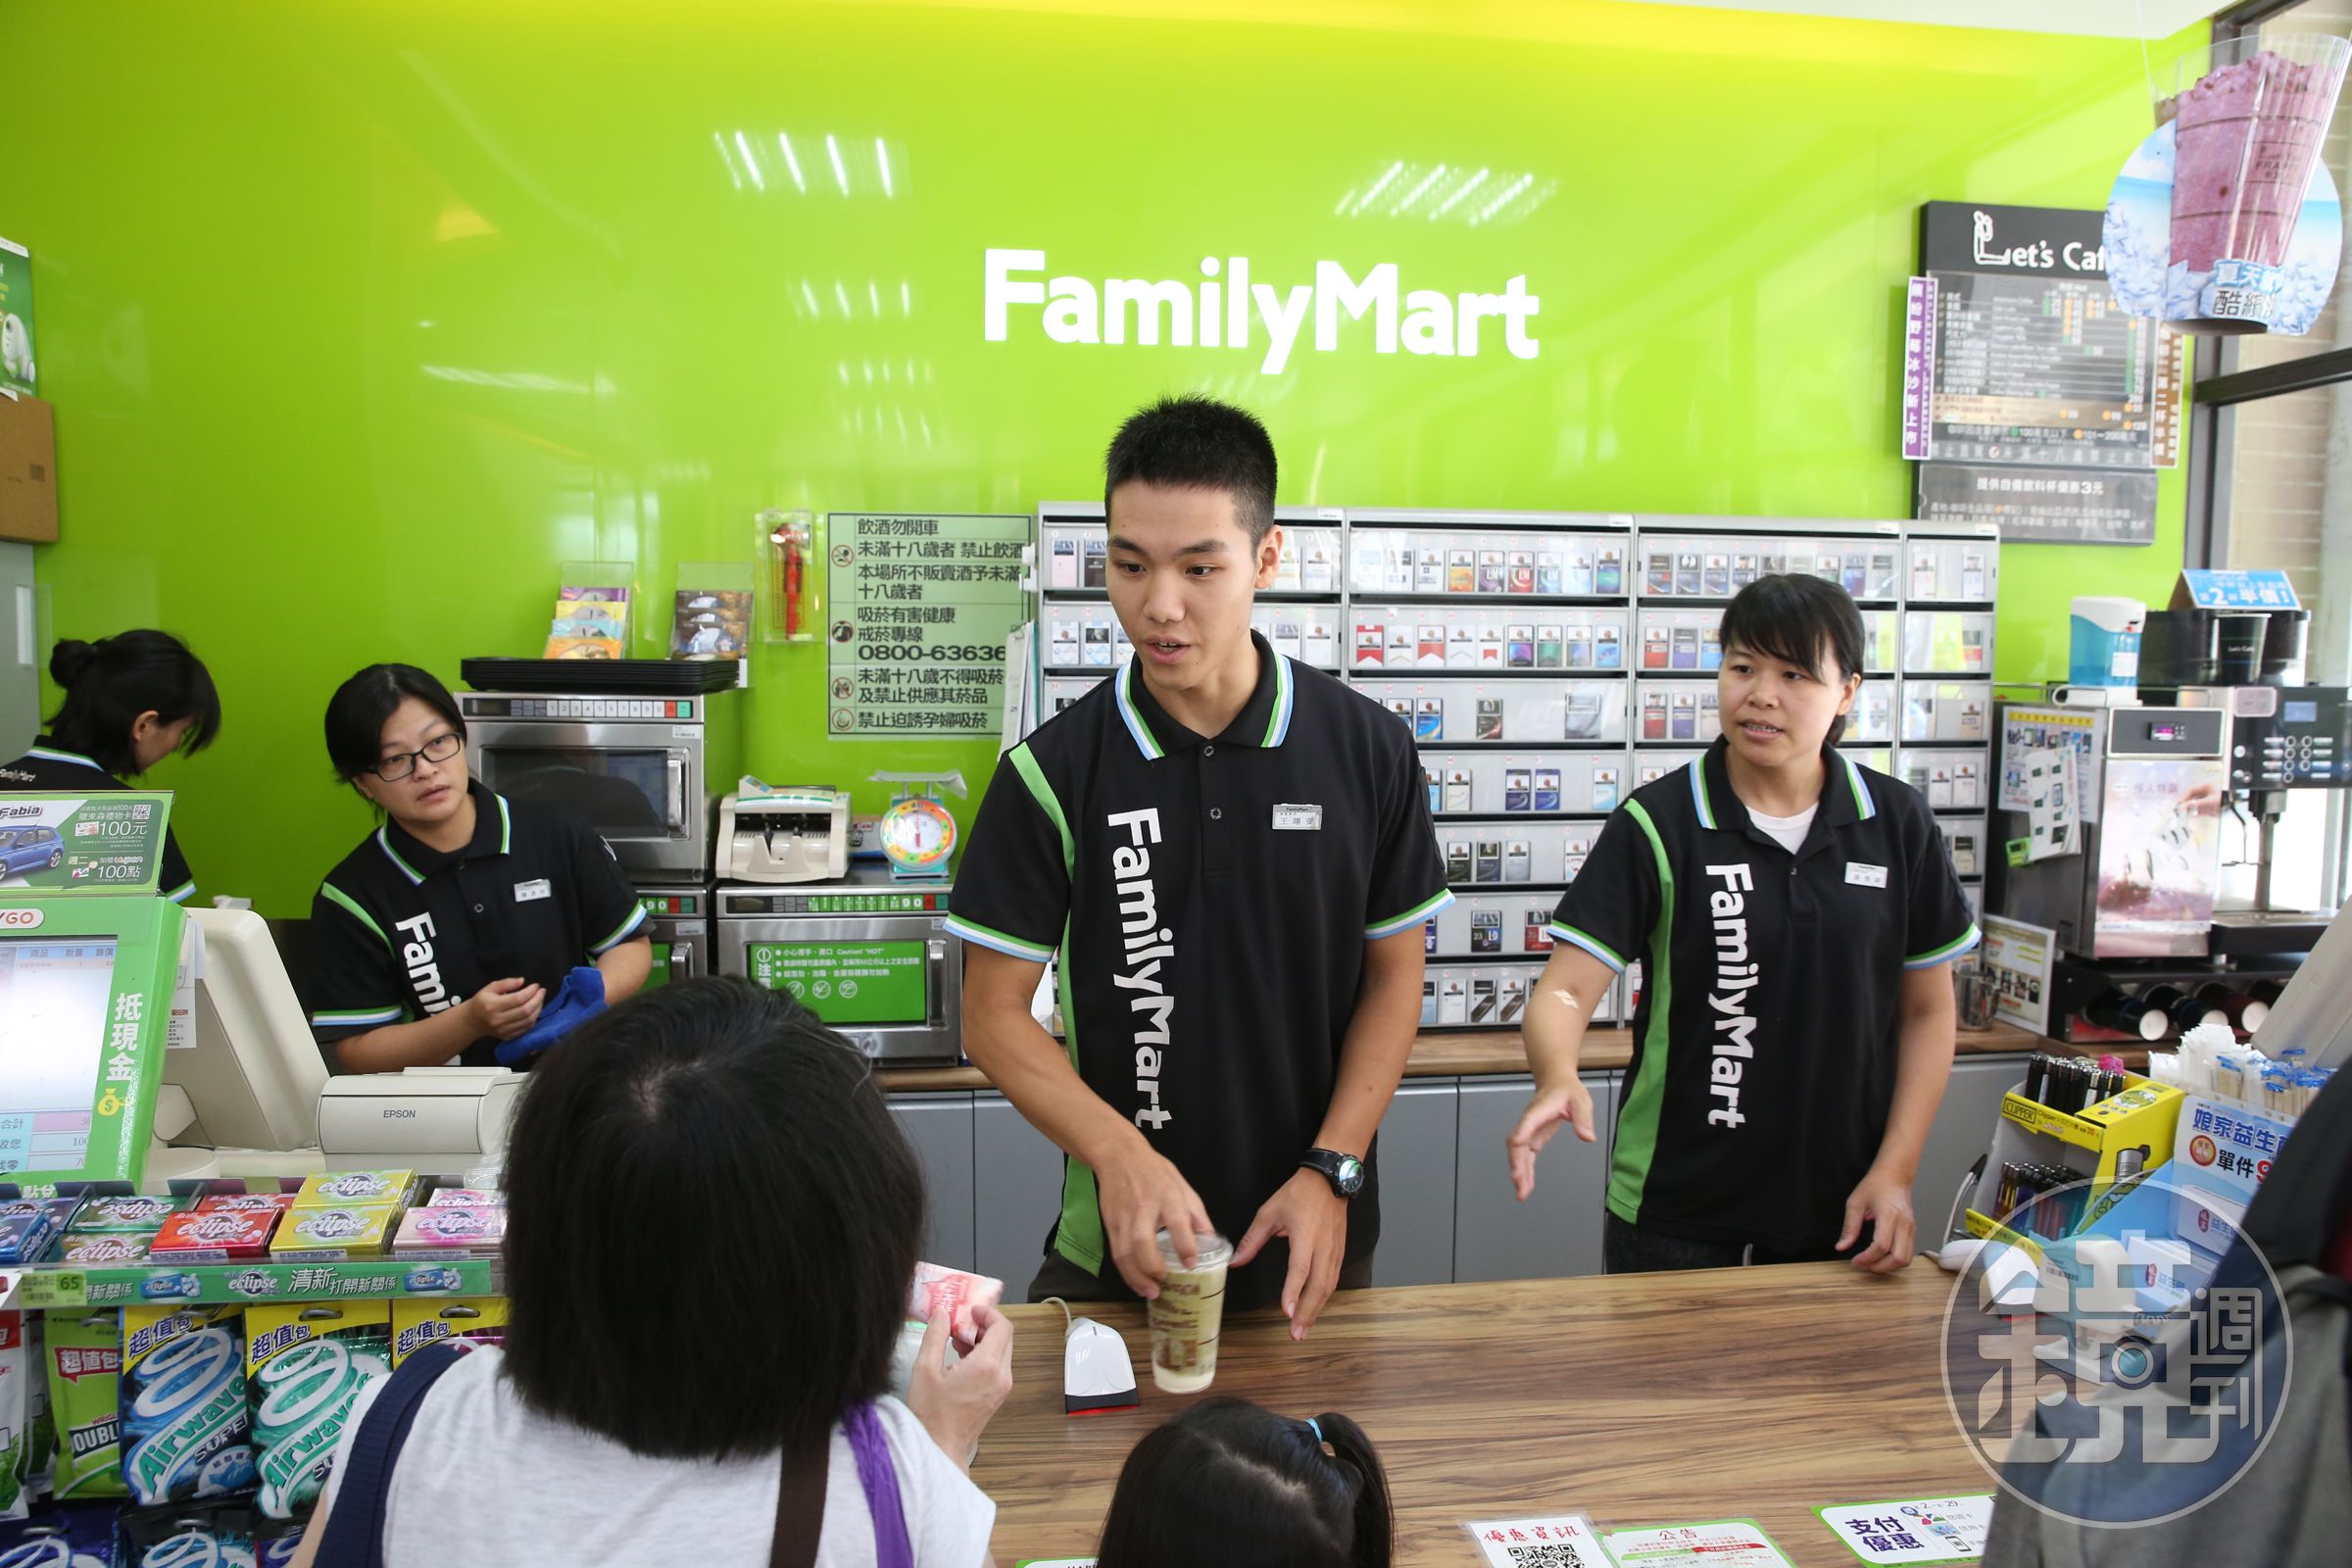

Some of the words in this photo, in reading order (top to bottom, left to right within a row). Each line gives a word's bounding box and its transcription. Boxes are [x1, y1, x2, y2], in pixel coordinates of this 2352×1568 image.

[1973, 210, 2054, 266] Let's
[2062, 241, 2108, 271] Caf
[984, 248, 1540, 375] FamilyMart
[858, 519, 939, 536] 飲酒勿開車
[858, 541, 956, 558] 未滿十八歲者
[858, 584, 923, 600] 十八歲者
[858, 607, 956, 623] 吸菸有害健康
[858, 626, 923, 642] 戒菸專線
[858, 646, 1005, 661] 0800-63636
[858, 668, 1004, 685] 未滿十八歲不得吸菸
[858, 688, 988, 704] 及禁止供應其菸品
[858, 712, 988, 728] 禁止迫誘孕婦吸菸
[99, 821, 147, 836] 100元
[97, 864, 140, 878] 100點
[395, 911, 462, 1016] Fami
[1107, 808, 1175, 1129] FamilyMart
[1705, 862, 1759, 1129] FamilyMart
[106, 992, 143, 1081] 抵現金
[383, 1108, 416, 1118] EPSON
[2004, 1100, 2035, 1120] CLIPPER
[317, 1176, 391, 1197] eclipse
[176, 1217, 254, 1239] eclipse
[295, 1213, 370, 1236] eclipse
[416, 1215, 493, 1236] eclipse
[65, 1239, 145, 1262] eclipse
[60, 1276, 80, 1290] 65
[228, 1273, 278, 1296] eclipse
[128, 1316, 194, 1360] 超值包
[250, 1323, 312, 1364] 超值包
[396, 1320, 452, 1357] 超值包
[60, 1349, 118, 1374] 超值包
[71, 1422, 119, 1454] OUBL
[138, 1375, 246, 1493] Airwave
[1484, 1525, 1581, 1544] 優惠資訊
[1659, 1528, 1697, 1541] 公告
[1844, 1515, 1906, 1536] 支付
[1863, 1533, 1926, 1553] 優惠
